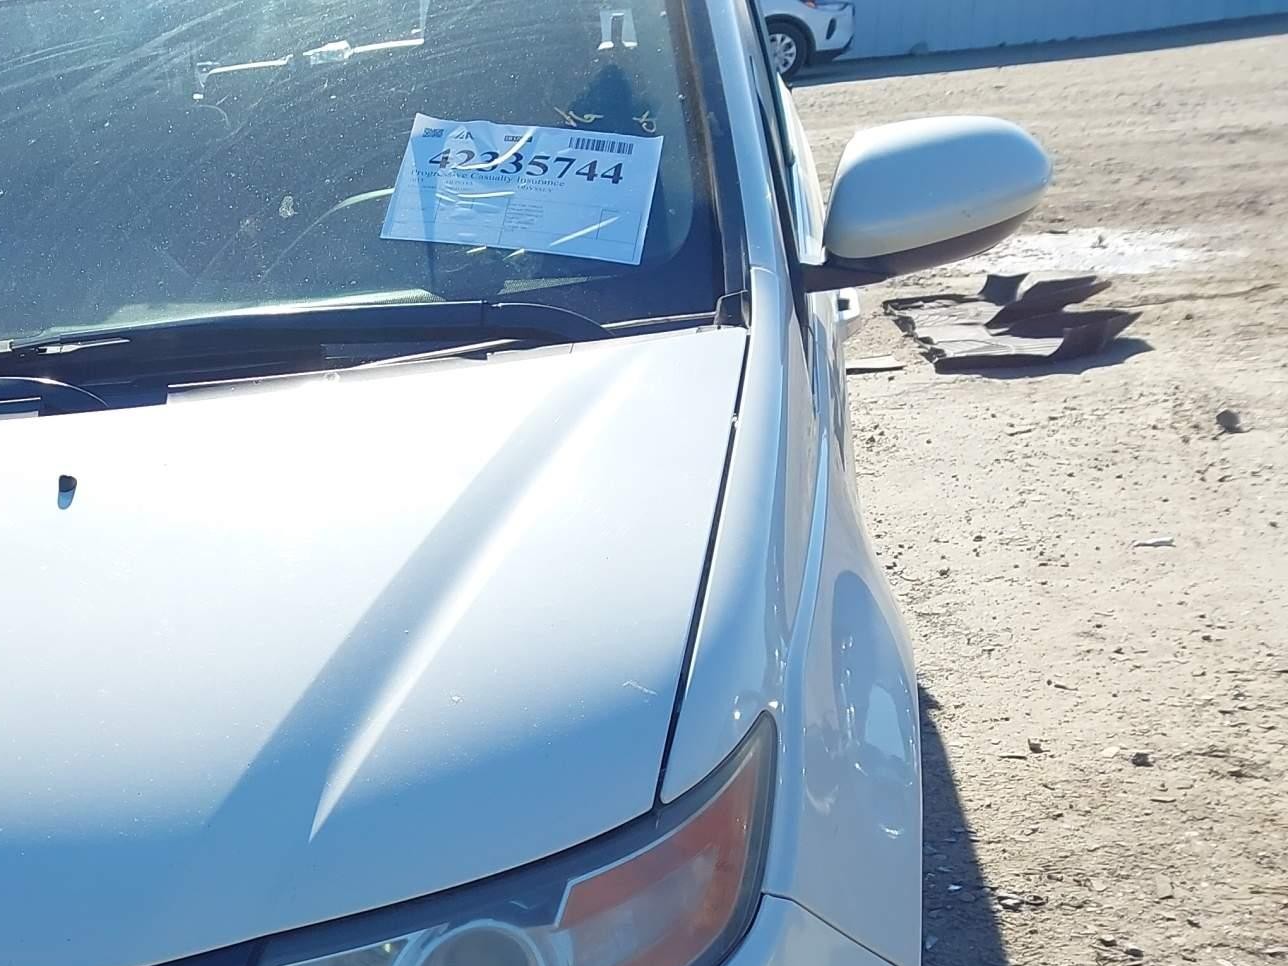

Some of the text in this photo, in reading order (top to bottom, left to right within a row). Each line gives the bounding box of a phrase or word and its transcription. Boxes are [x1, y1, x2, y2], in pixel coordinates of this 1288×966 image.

[428, 147, 624, 185] 42335744
[470, 171, 512, 184] Casualty
[516, 175, 566, 187] Insurance
